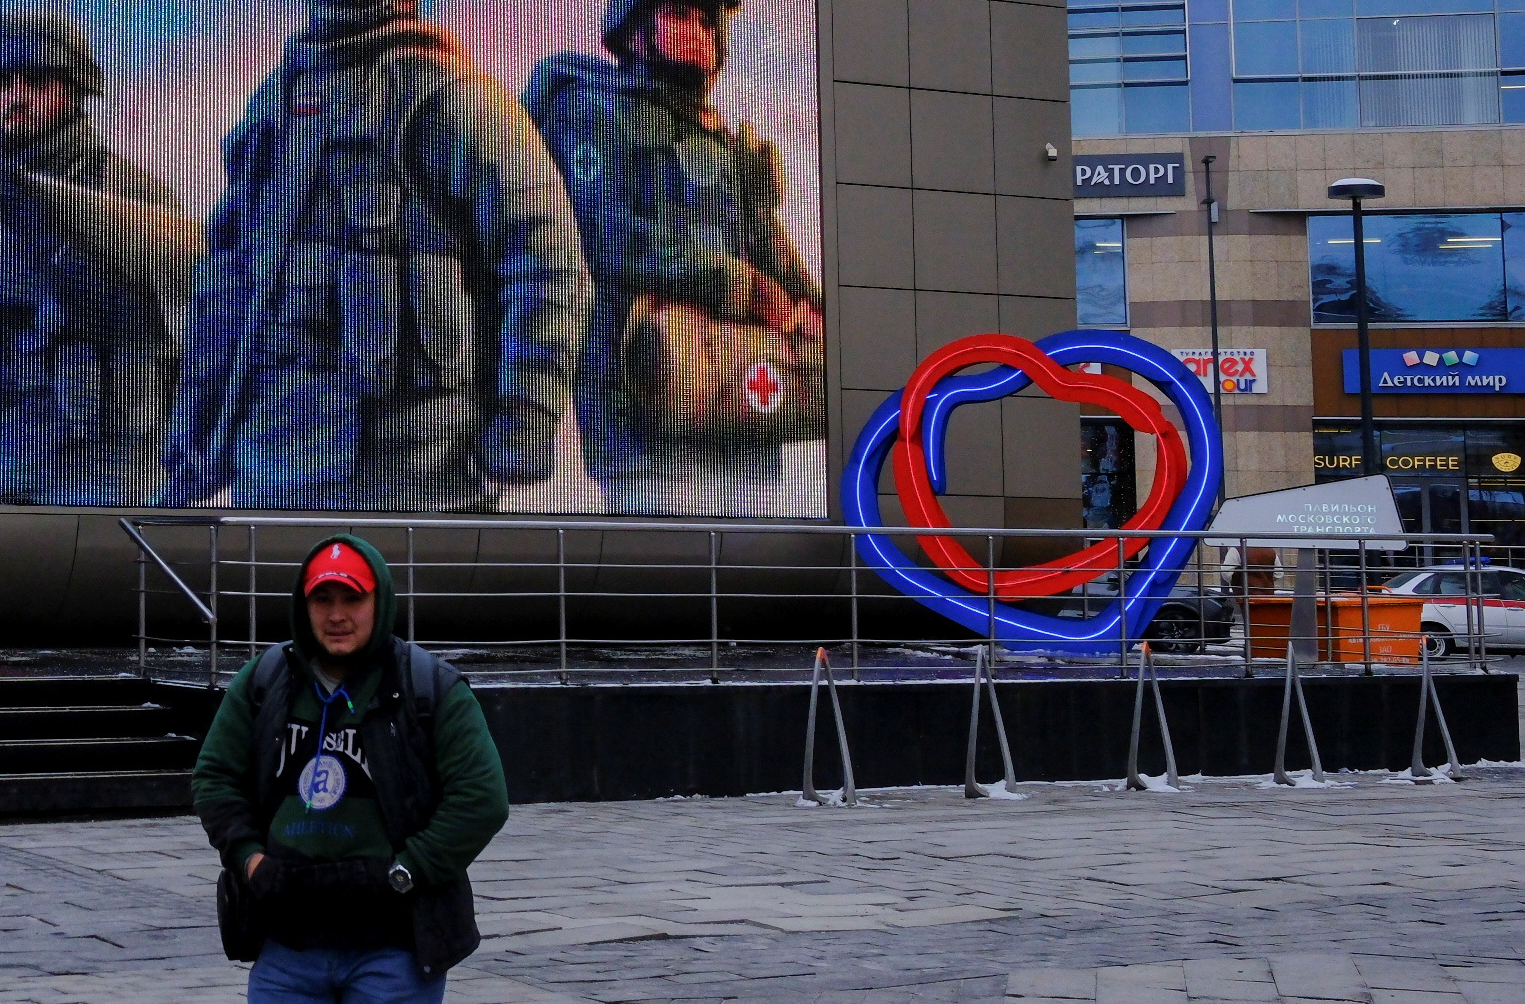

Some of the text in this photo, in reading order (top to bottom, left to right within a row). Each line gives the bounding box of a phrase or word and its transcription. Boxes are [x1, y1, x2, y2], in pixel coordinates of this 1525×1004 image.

[1075, 163, 1180, 186] РАТОРГ
[1220, 378, 1257, 393] our
[1378, 371, 1507, 392] Детский мир
[1314, 455, 1460, 470] SURF COFFEE
[1304, 503, 1377, 513] ПАВИЛЬОН
[1276, 514, 1377, 524] МОСКОВСКОГО
[1293, 525, 1376, 533] ТРАНСПОРТА
